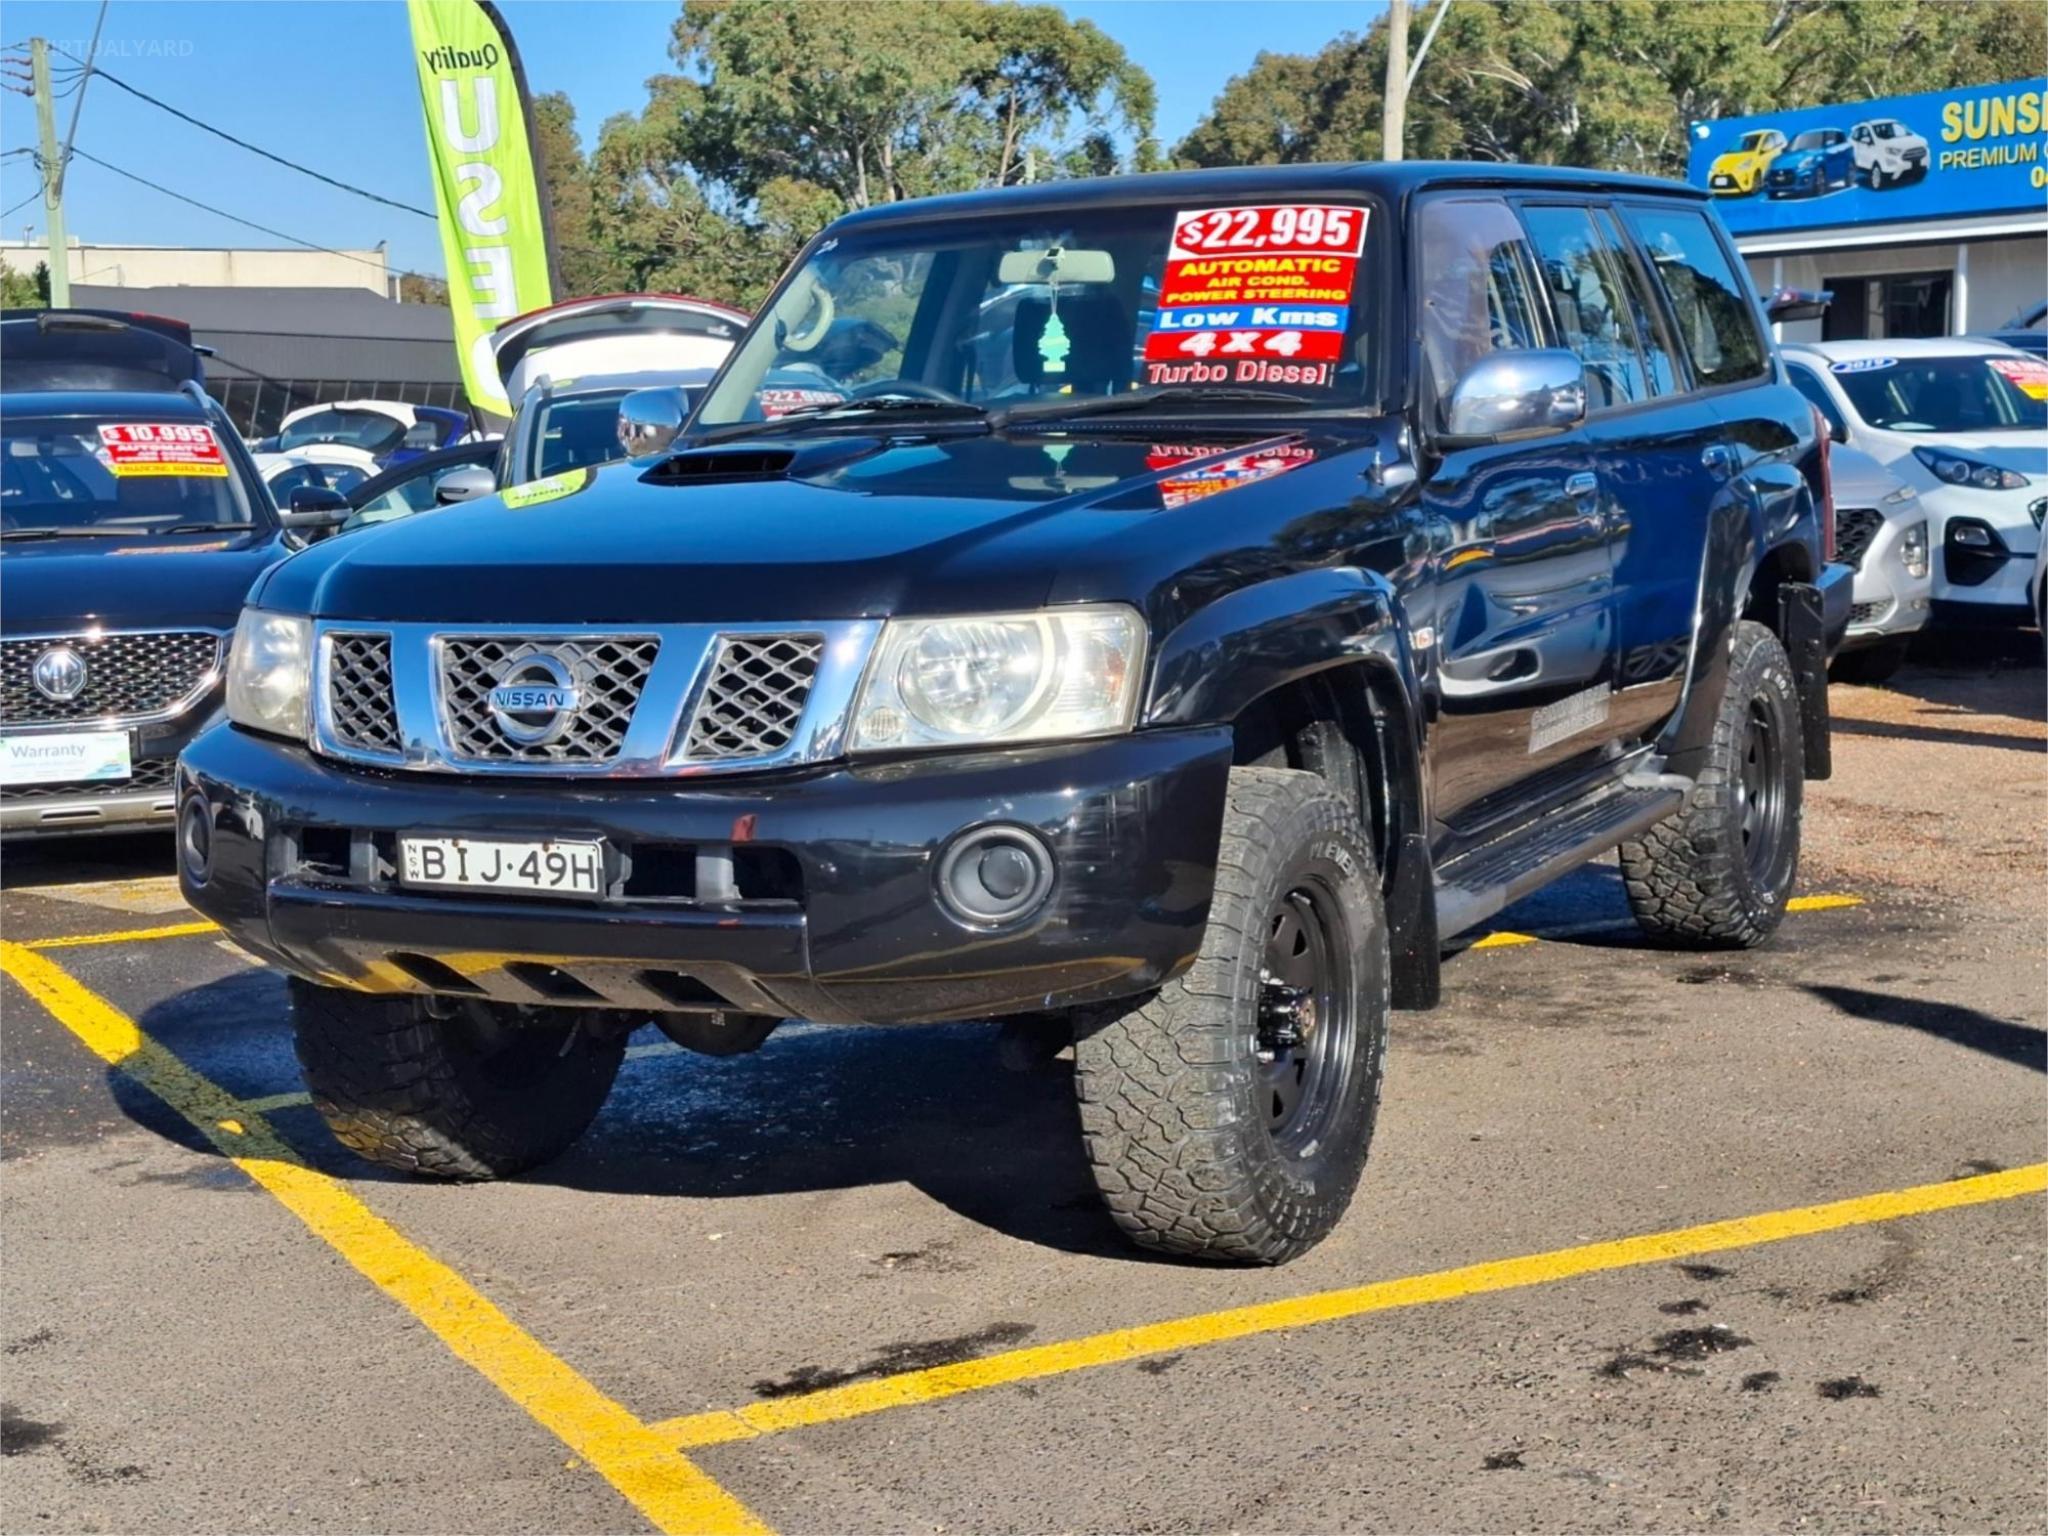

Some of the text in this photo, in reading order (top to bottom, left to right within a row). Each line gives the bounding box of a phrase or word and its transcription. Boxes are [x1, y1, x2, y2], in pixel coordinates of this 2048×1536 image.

[1940, 142, 2037, 170] PREMIUM
[2031, 166, 2048, 188] 0
[1182, 208, 1353, 248] $22,995
[1178, 257, 1342, 277] AUTOMATIC
[1206, 276, 1310, 288] AIR COND.
[1166, 288, 1347, 303] POWER STEERING
[1159, 307, 1339, 329] Low Kms
[1148, 360, 1327, 385] Turbo Diesel
[496, 692, 565, 706] NISSAN
[11, 744, 86, 758] Warranty
